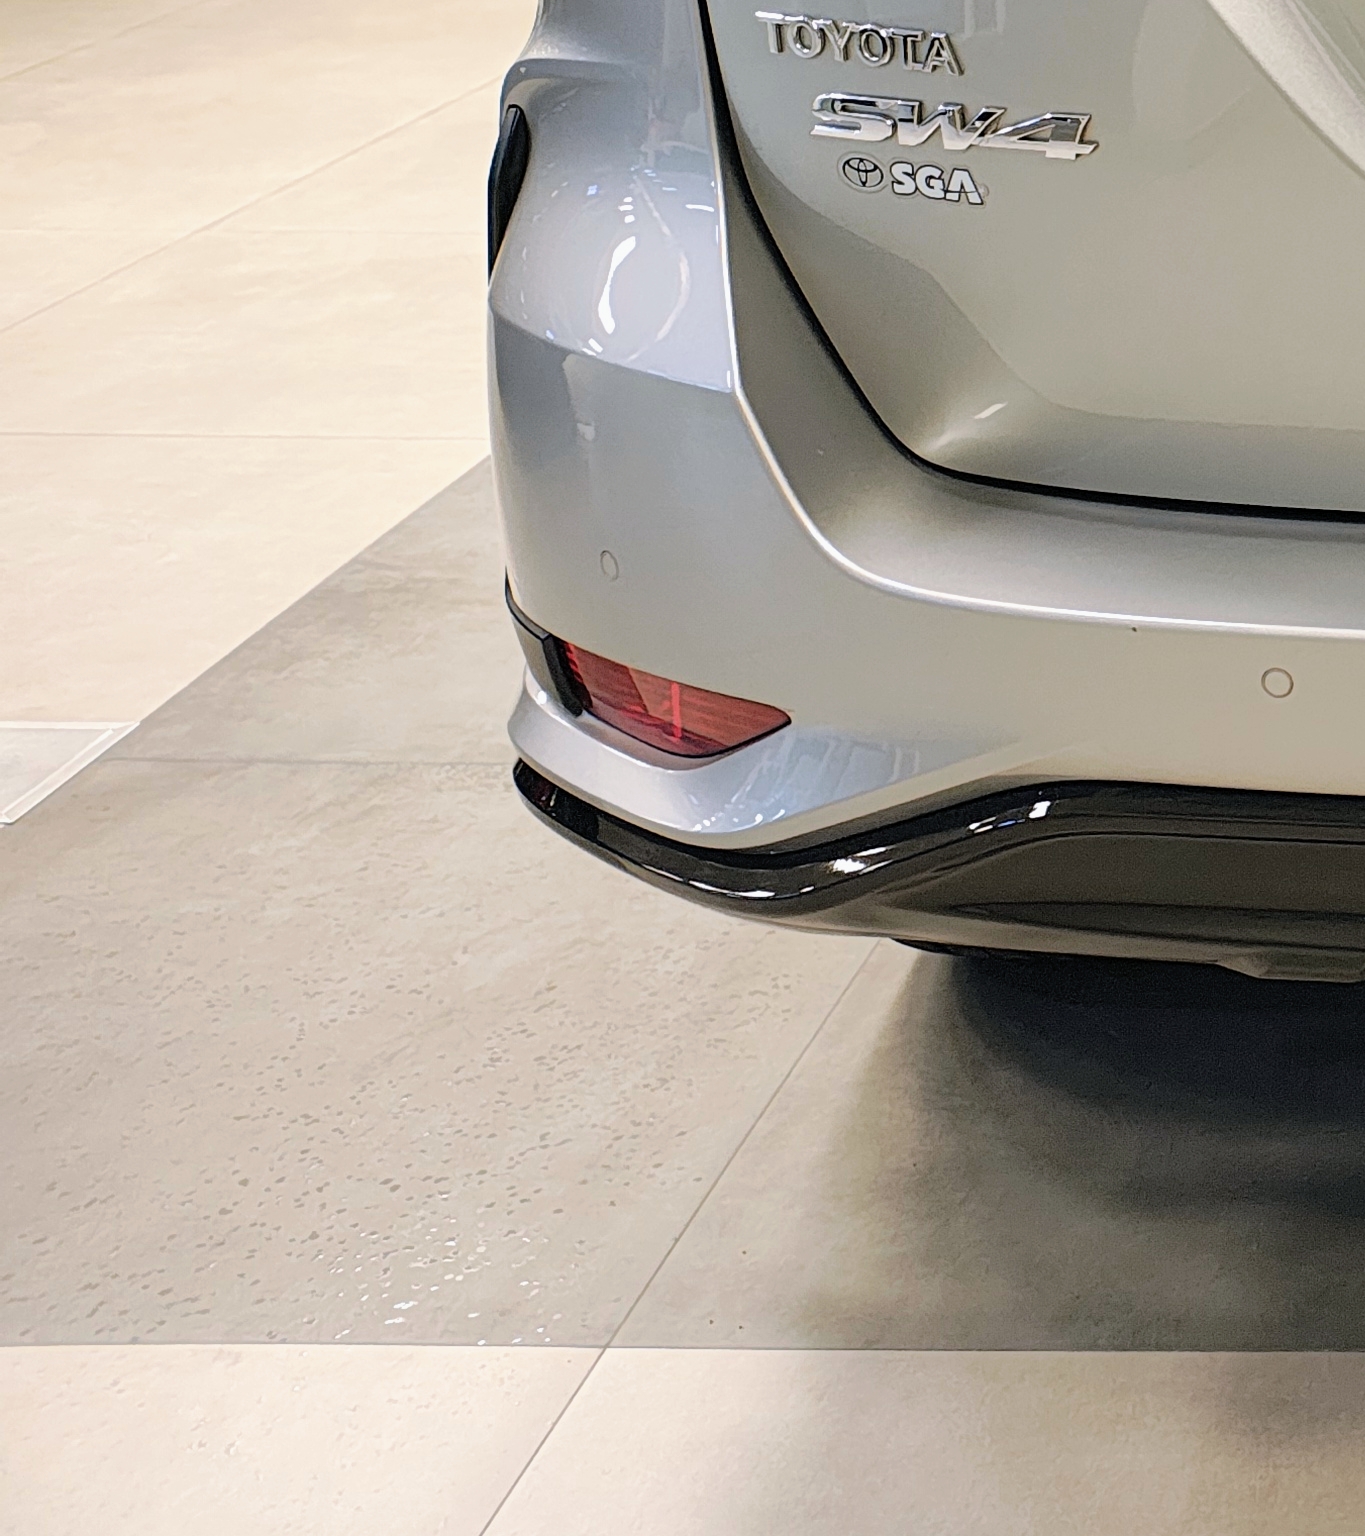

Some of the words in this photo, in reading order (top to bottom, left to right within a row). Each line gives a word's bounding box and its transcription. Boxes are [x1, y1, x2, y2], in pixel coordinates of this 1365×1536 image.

[755, 11, 964, 76] TOYOTA
[810, 92, 1099, 160] SW4
[891, 161, 984, 205] SGA
